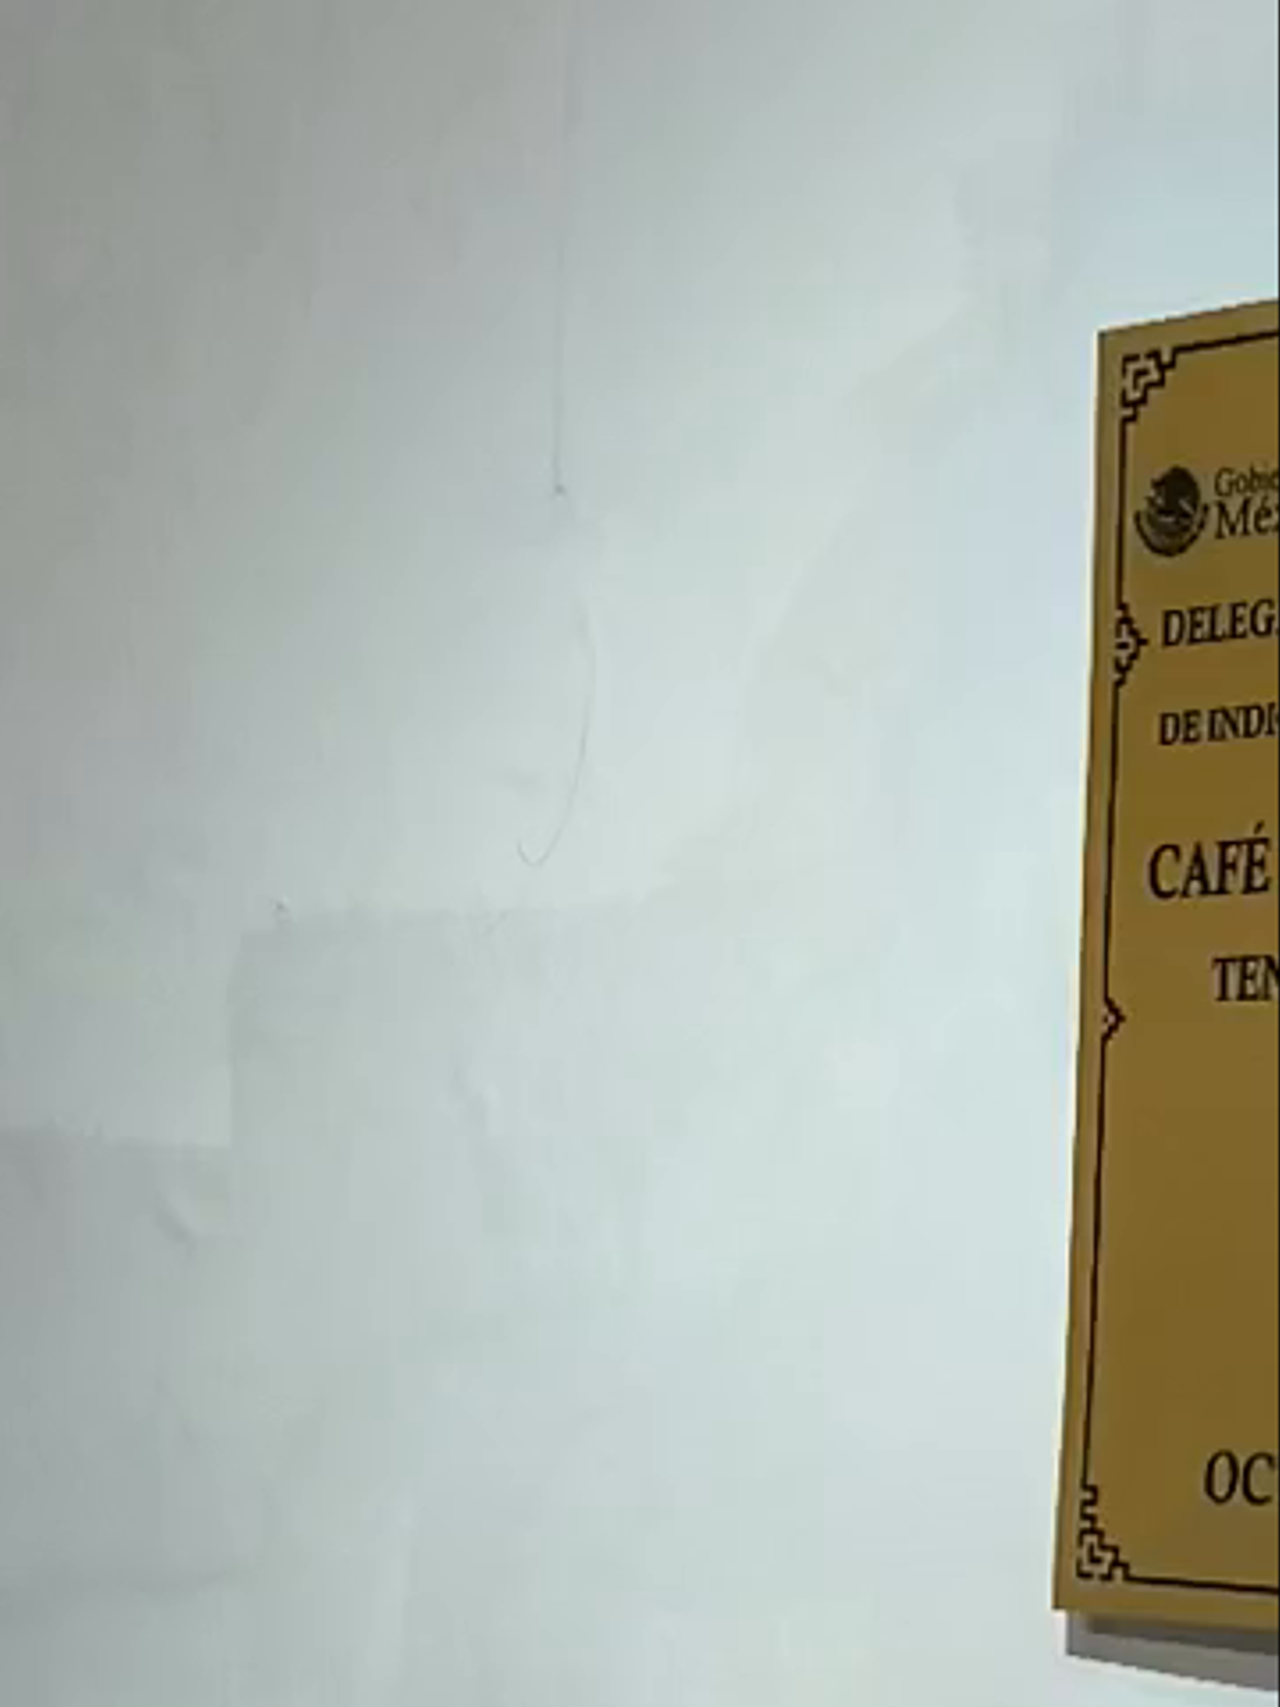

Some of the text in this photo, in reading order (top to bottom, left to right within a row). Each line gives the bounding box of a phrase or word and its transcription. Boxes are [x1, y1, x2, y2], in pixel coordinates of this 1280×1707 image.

[1213, 495, 1278, 539] Mé
[1161, 597, 1278, 647] DELEG
[1159, 702, 1278, 745] DE INDI
[1149, 820, 1271, 899] CAFÉ
[1204, 1449, 1276, 1506] OC
